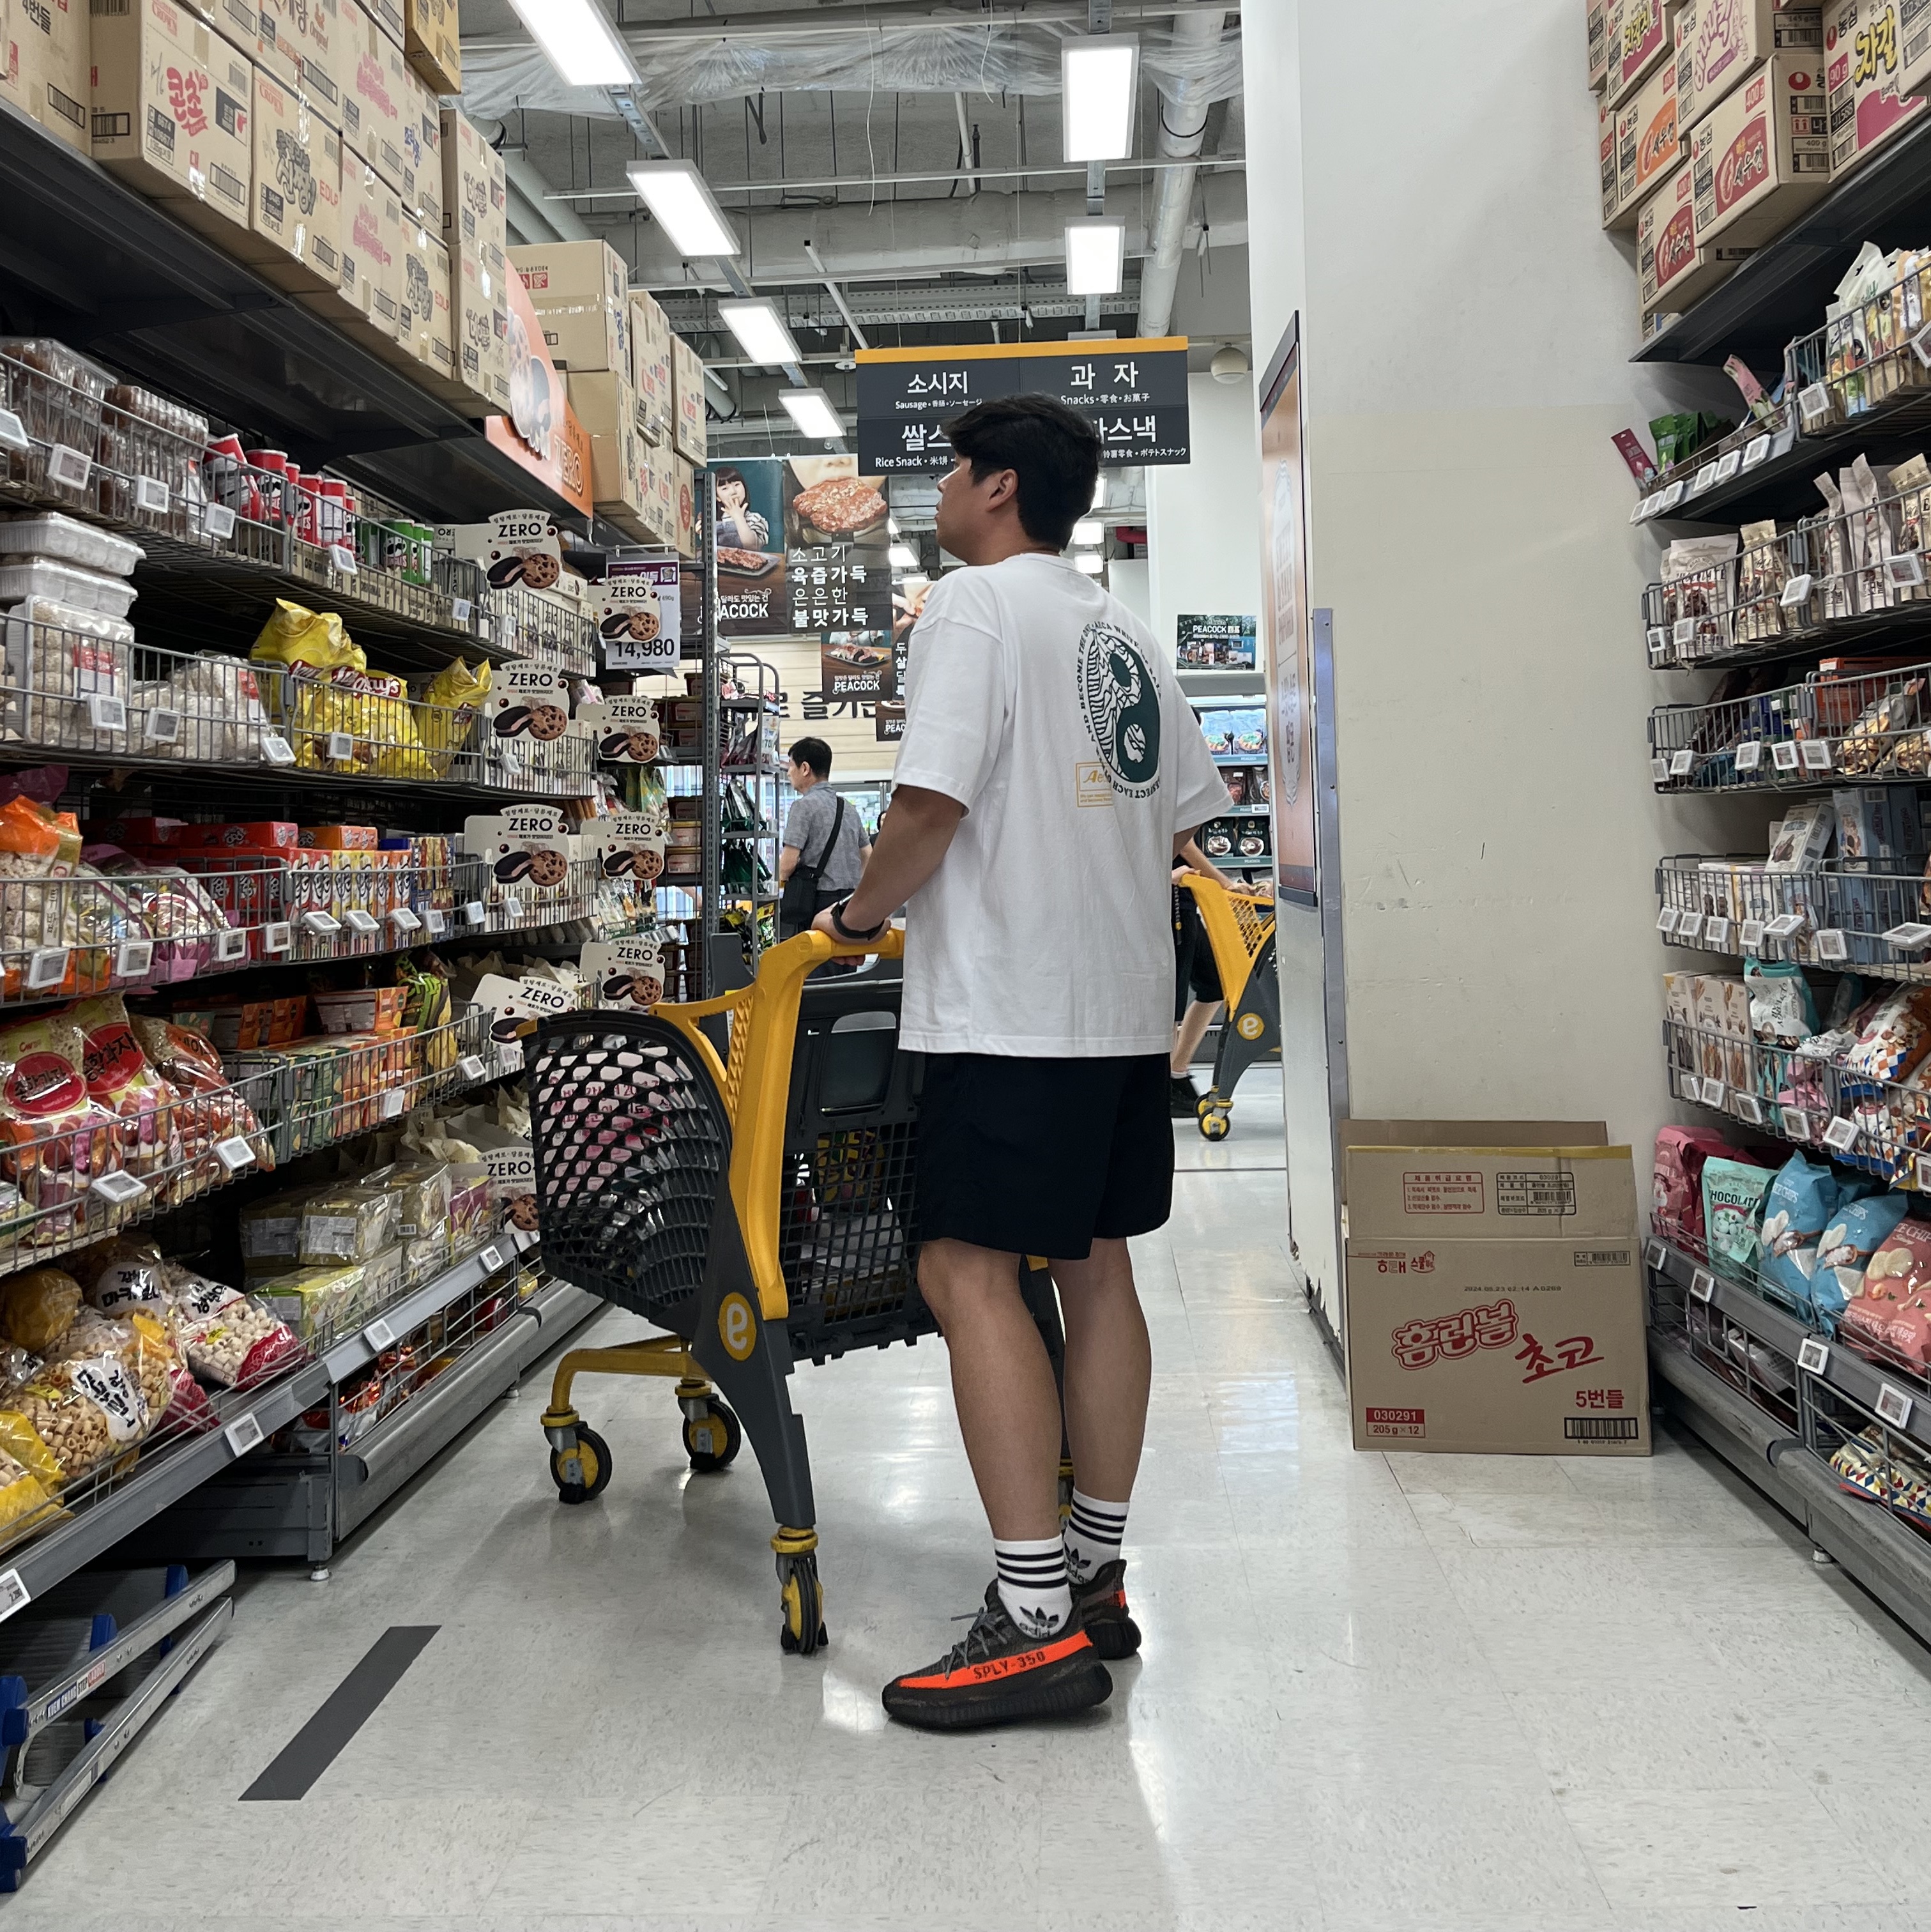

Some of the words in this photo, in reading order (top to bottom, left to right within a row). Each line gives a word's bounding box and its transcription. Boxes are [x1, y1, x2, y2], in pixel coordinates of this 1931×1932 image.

[1683, 12, 1696, 39] 농심
[1839, 5, 1858, 38] 농심
[1854, 4, 1898, 88] 자갈
[1700, 128, 1712, 151] 농심
[1734, 141, 1764, 187] 새우깡
[319, 179, 339, 208] EDLP
[907, 371, 968, 395] 소시지
[896, 401, 927, 410] Sausage
[1060, 394, 1095, 405] Snacks
[902, 424, 952, 451] 쌀스
[553, 436, 584, 496] ZERO
[875, 456, 894, 468] Rice
[896, 455, 922, 467] Snack
[498, 523, 542, 537] ZERO
[791, 544, 847, 563] 소고기
[791, 565, 867, 585] 육즙가득
[611, 586, 646, 597] ZERO
[741, 594, 760, 603] 맛있는
[761, 594, 768, 602] 건
[792, 586, 848, 606] 은은한
[792, 607, 869, 629] 불맛가득
[1193, 625, 1226, 634] PEACOCK
[615, 639, 675, 659] 14,980
[508, 673, 553, 687] ZERO
[834, 680, 880, 691] PEACOCK
[1077, 657, 1086, 710] BECOME
[611, 705, 646, 717] ZERO
[885, 724, 906, 733] PEAC
[508, 818, 553, 831] ZERO
[616, 824, 651, 834] ZERO
[616, 947, 653, 960] ZERO
[521, 987, 565, 1008] ZERO
[487, 1161, 531, 1177] ZERO
[1907, 1227, 1931, 1243] CHIP
[1393, 1299, 1518, 1370] 홈런볼
[1515, 1333, 1605, 1384] 초코
[1575, 1389, 1625, 1409] 5번들
[1373, 1410, 1417, 1422] 030291
[1407, 1425, 1419, 1435] 12
[973, 1652, 1046, 1680] SPLY-350
